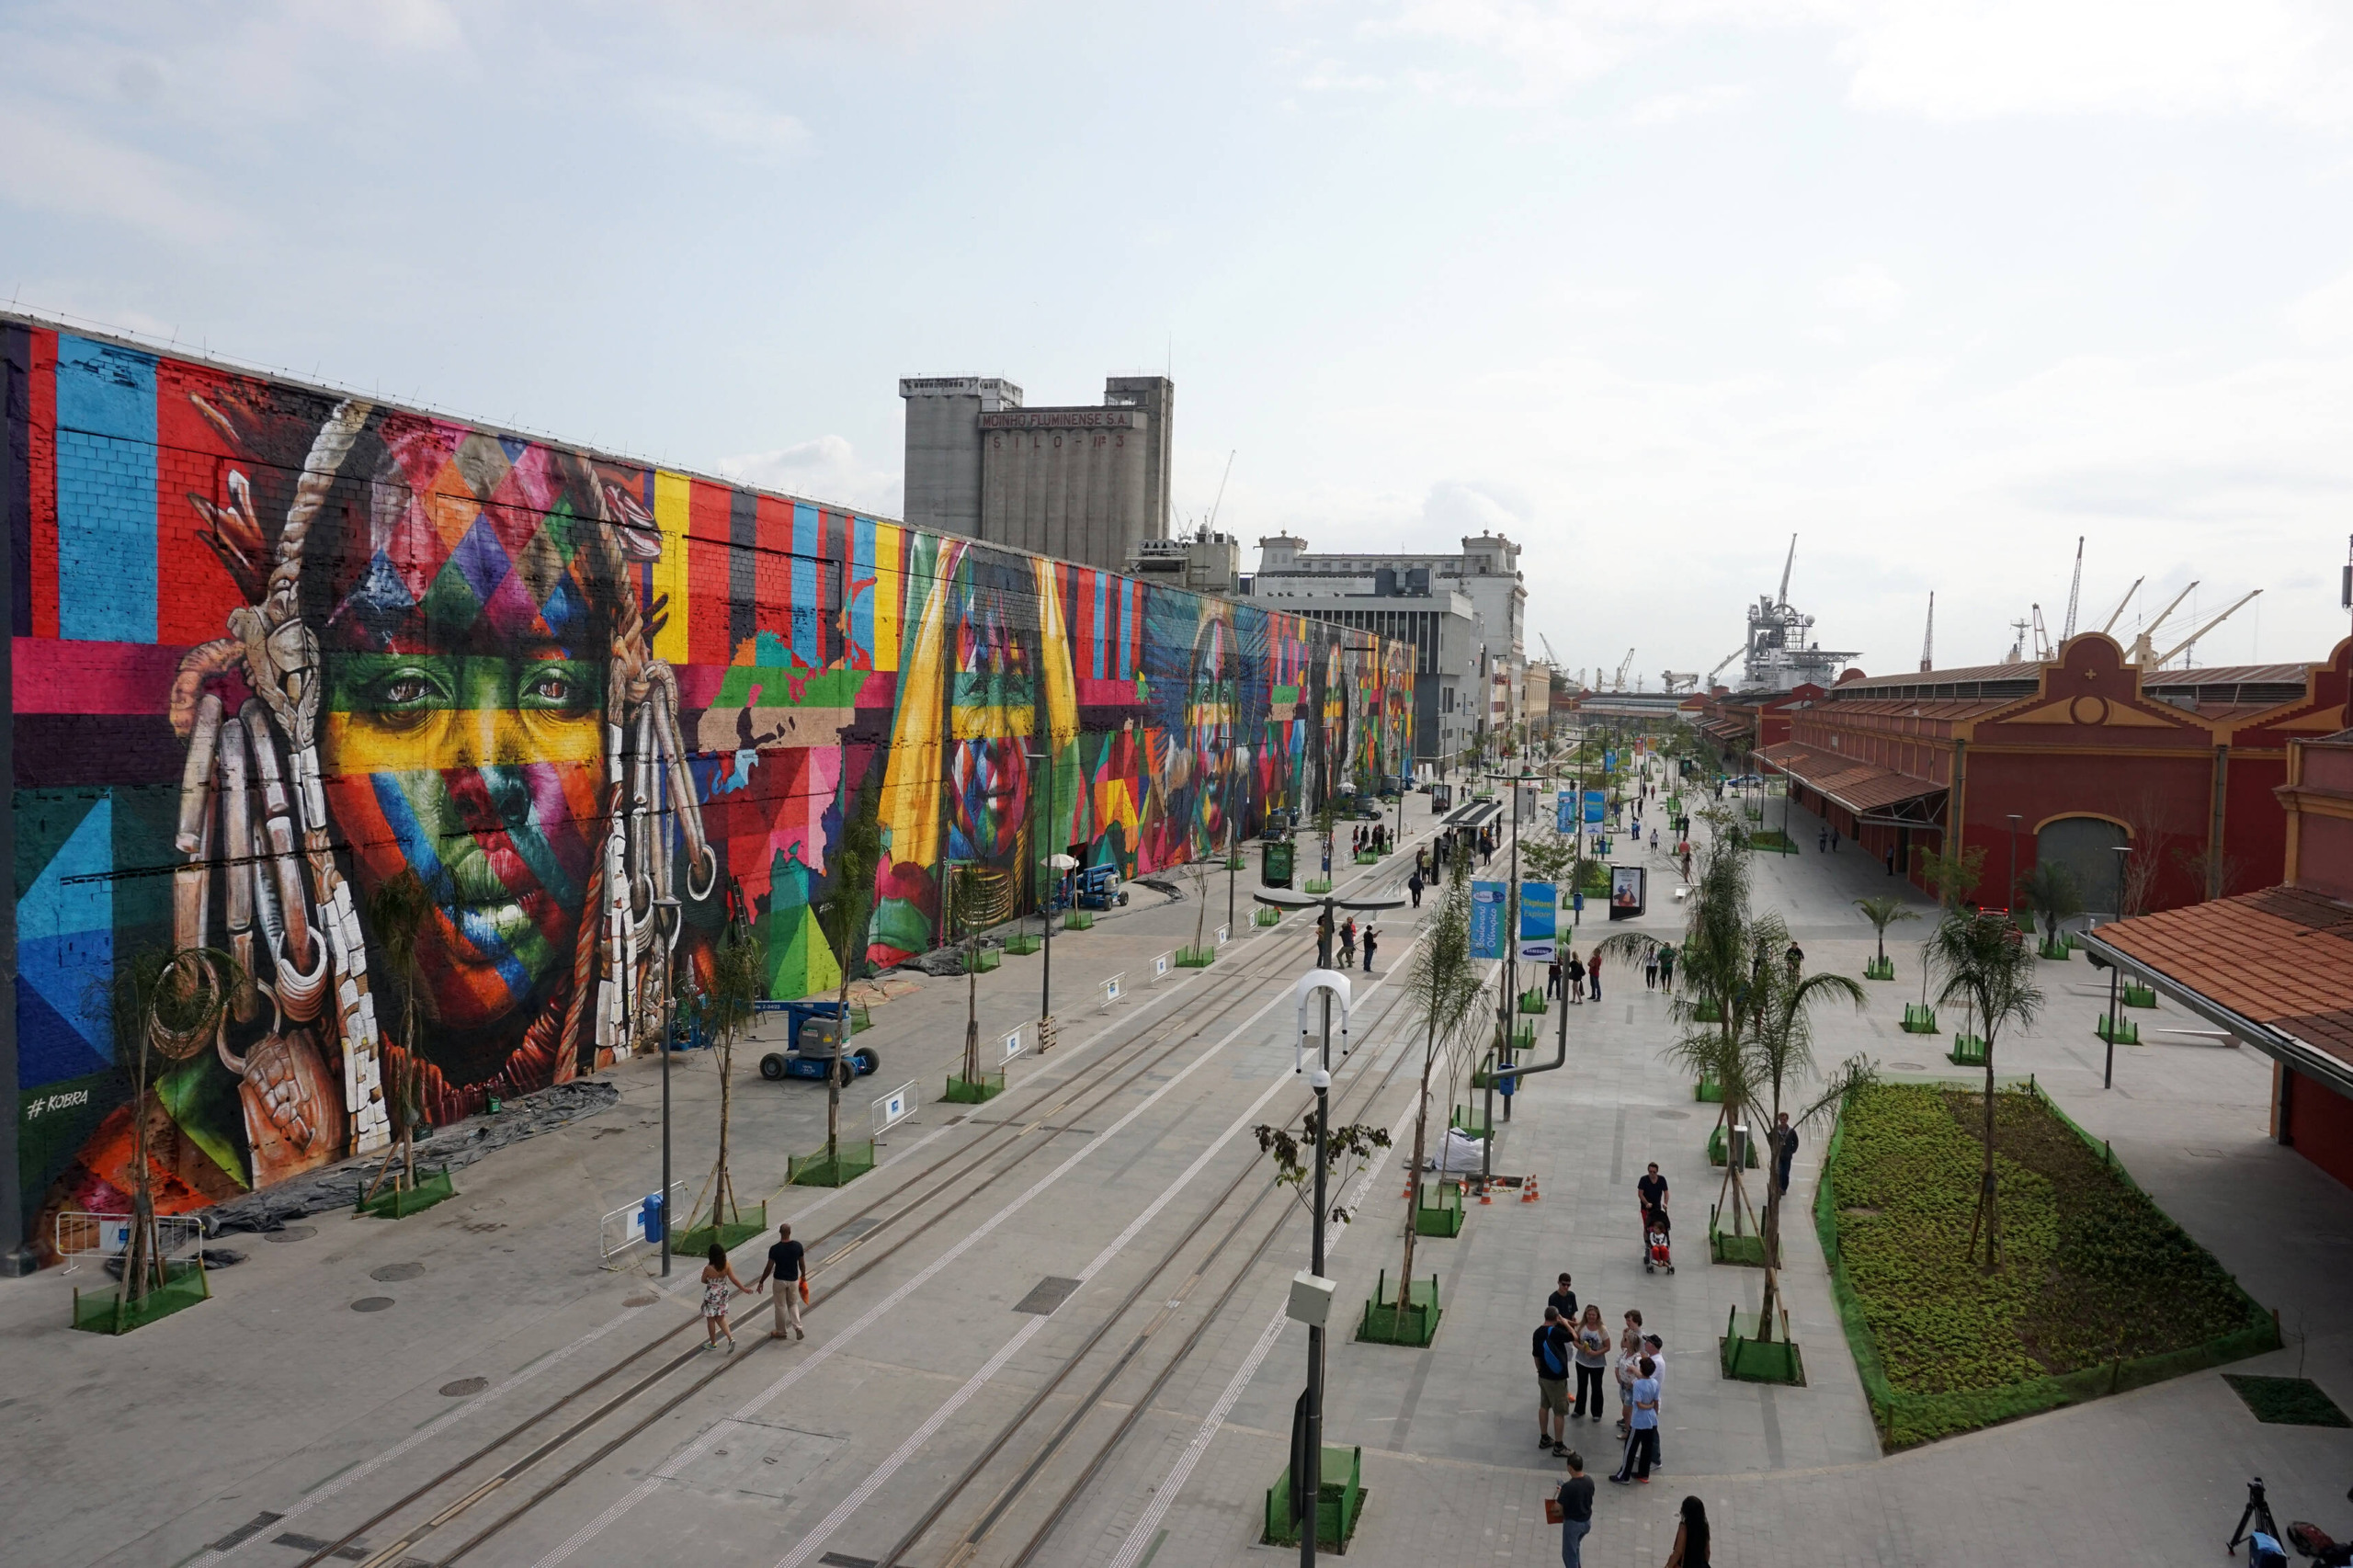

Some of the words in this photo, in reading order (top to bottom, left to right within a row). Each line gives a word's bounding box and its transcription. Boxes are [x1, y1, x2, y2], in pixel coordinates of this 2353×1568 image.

[983, 415, 1026, 427] MOINHO
[1030, 413, 1101, 426] FLUMINENSE
[1107, 413, 1128, 425] S.A.
[1116, 435, 1124, 448] 3
[1523, 897, 1554, 908] Explore!
[1475, 905, 1486, 949] Boulevard
